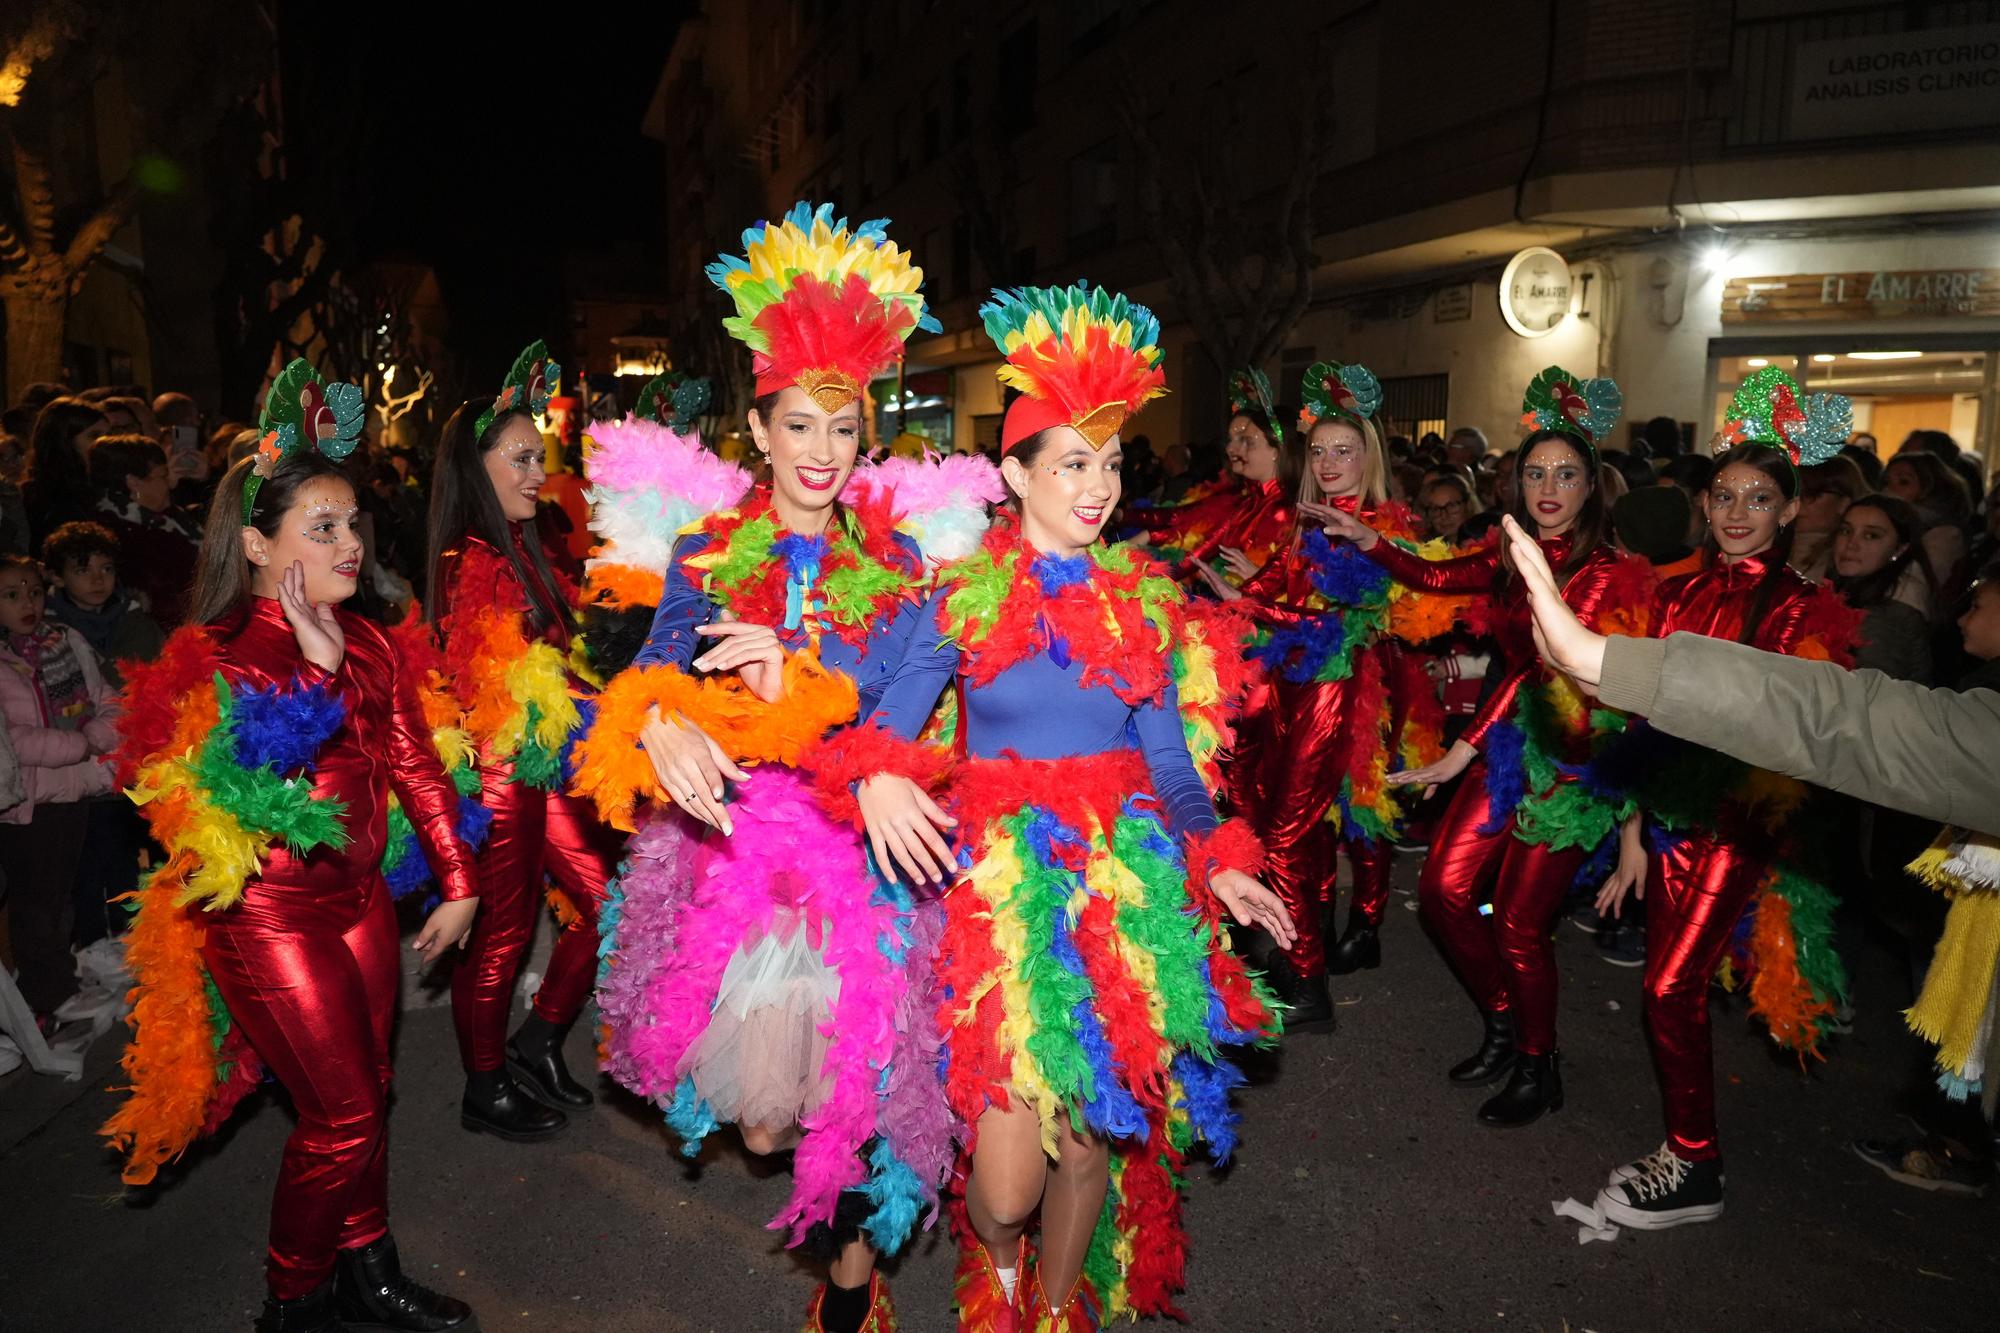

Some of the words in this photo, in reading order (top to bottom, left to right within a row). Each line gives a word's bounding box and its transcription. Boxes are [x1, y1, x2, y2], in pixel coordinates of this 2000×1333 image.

[1828, 43, 2000, 75] LABORATORIO
[1805, 76, 1910, 101] ANALISIS
[1822, 275, 1848, 303] EL
[1867, 272, 1981, 299] AMARRE
